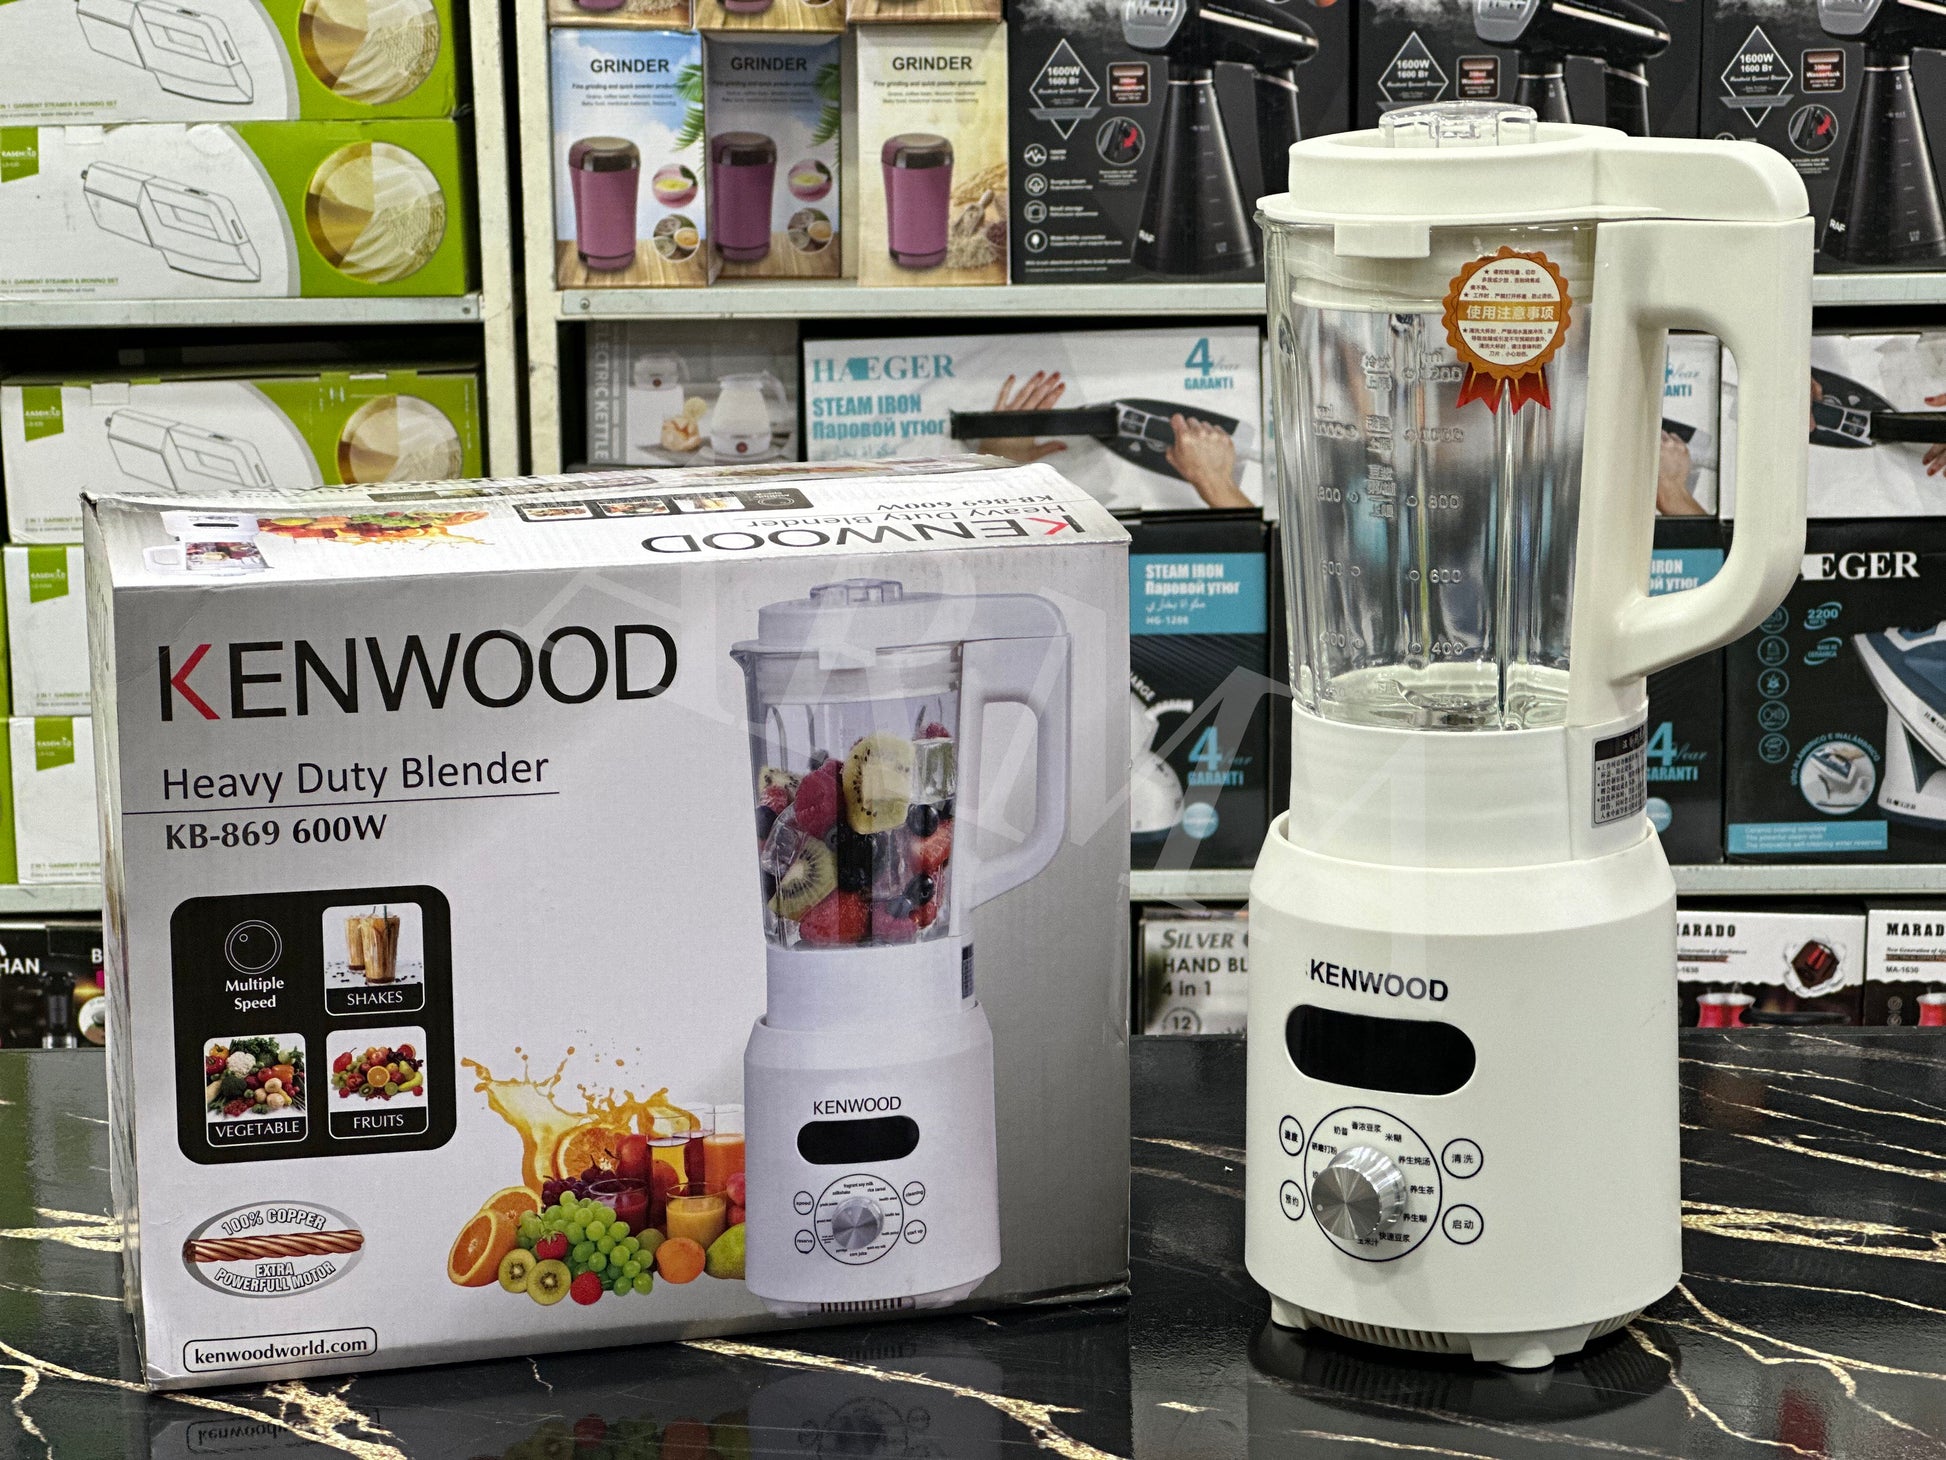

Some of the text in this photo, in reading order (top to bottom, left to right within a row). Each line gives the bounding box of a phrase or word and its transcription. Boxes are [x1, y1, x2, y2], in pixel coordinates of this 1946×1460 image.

[590, 58, 670, 73] GRINDER
[730, 57, 808, 71] GRINDER
[892, 56, 973, 71] GRINDER
[1397, 59, 1430, 69] 1600W
[1740, 53, 1774, 63] 1600W
[1047, 65, 1081, 76] 1600W
[1740, 64, 1760, 73] 1600
[1829, 218, 1846, 232] RAF
[1466, 304, 1554, 320] 使用注意事项
[1185, 336, 1214, 376] 4
[813, 354, 956, 382] HAEGER
[1184, 377, 1234, 390] GARANTI
[1665, 384, 1692, 397] ANTI
[813, 393, 922, 417] STEAM IRON
[813, 417, 946, 440] Паровой утюг
[877, 499, 945, 512] 600W
[748, 504, 1066, 528] Heavy Duty Blender
[641, 513, 1087, 553] KENWOOD
[1145, 563, 1224, 579] STEAM IRON
[1429, 568, 1462, 583] 600
[1207, 581, 1240, 597] утюг
[1807, 608, 1839, 620] 2200
[1431, 641, 1464, 655] 400
[158, 623, 678, 721] KENWOOD
[1187, 726, 1223, 771] 4
[1647, 721, 1678, 767] 4
[163, 750, 549, 803] Heavy Duty Blender
[1188, 770, 1245, 786] GARANTI
[165, 814, 388, 850] KB-869 600W
[1163, 957, 1221, 973] HAND
[225, 976, 284, 993] Multiple
[1310, 958, 1449, 1001] KENWOOD
[1162, 980, 1211, 996] 4 in 1
[234, 995, 276, 1012] Speed
[347, 991, 403, 1006] SHAKES
[1173, 1016, 1192, 1030] 12
[813, 1096, 902, 1116] KENWOOD
[215, 1120, 300, 1138] VEGETABLE
[353, 1114, 404, 1129] FRUITS
[1351, 1121, 1382, 1133] 香浓豆浆
[1385, 1133, 1402, 1143] 米糊
[1451, 1154, 1474, 1164] 清洗
[905, 1190, 924, 1198] cleaning
[1409, 1185, 1435, 1195] 养生茶
[221, 1208, 327, 1236] 100% COPPER
[1403, 1213, 1428, 1224] 养生糊
[1452, 1219, 1474, 1230] 启动
[1379, 1231, 1410, 1243] 快速豆浆
[215, 1261, 336, 1292] POWERFULL MOTOR
[255, 1262, 294, 1277] EXTRA
[195, 1339, 367, 1364] kenwoodworld.com
